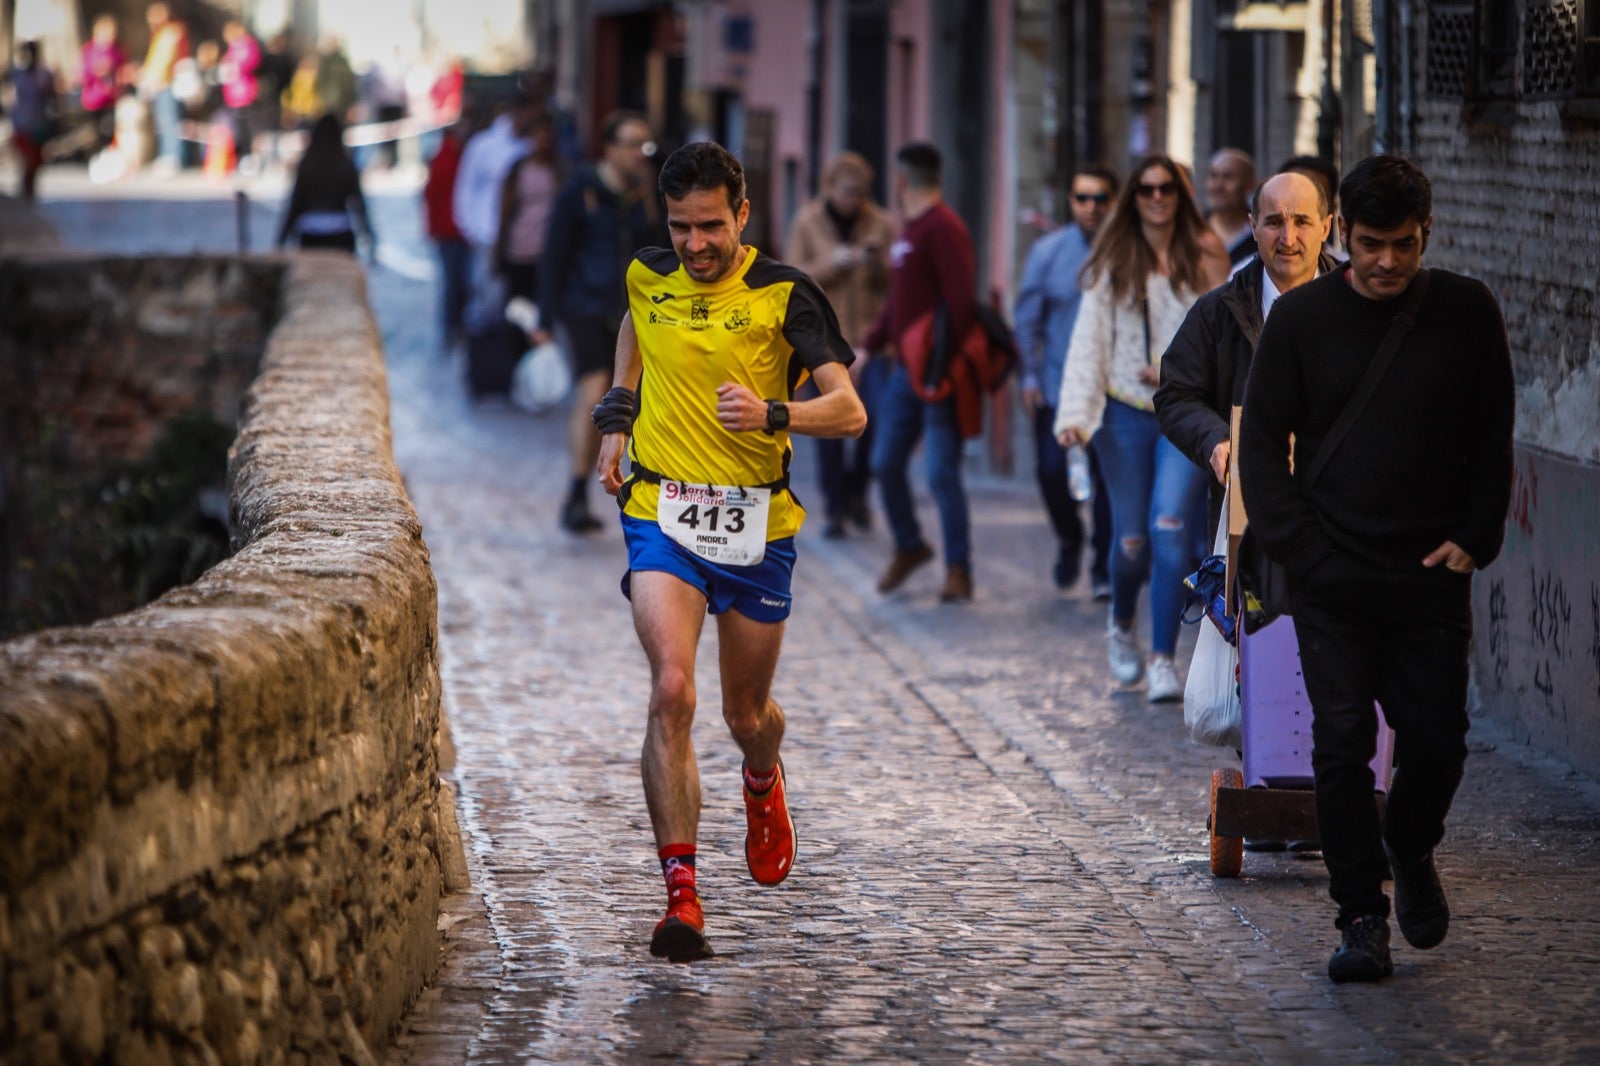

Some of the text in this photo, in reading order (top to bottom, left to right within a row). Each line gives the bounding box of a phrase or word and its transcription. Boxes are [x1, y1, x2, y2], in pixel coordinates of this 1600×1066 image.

[665, 483, 679, 499] 9
[678, 504, 745, 534] 413
[696, 535, 728, 545] ANDRES
